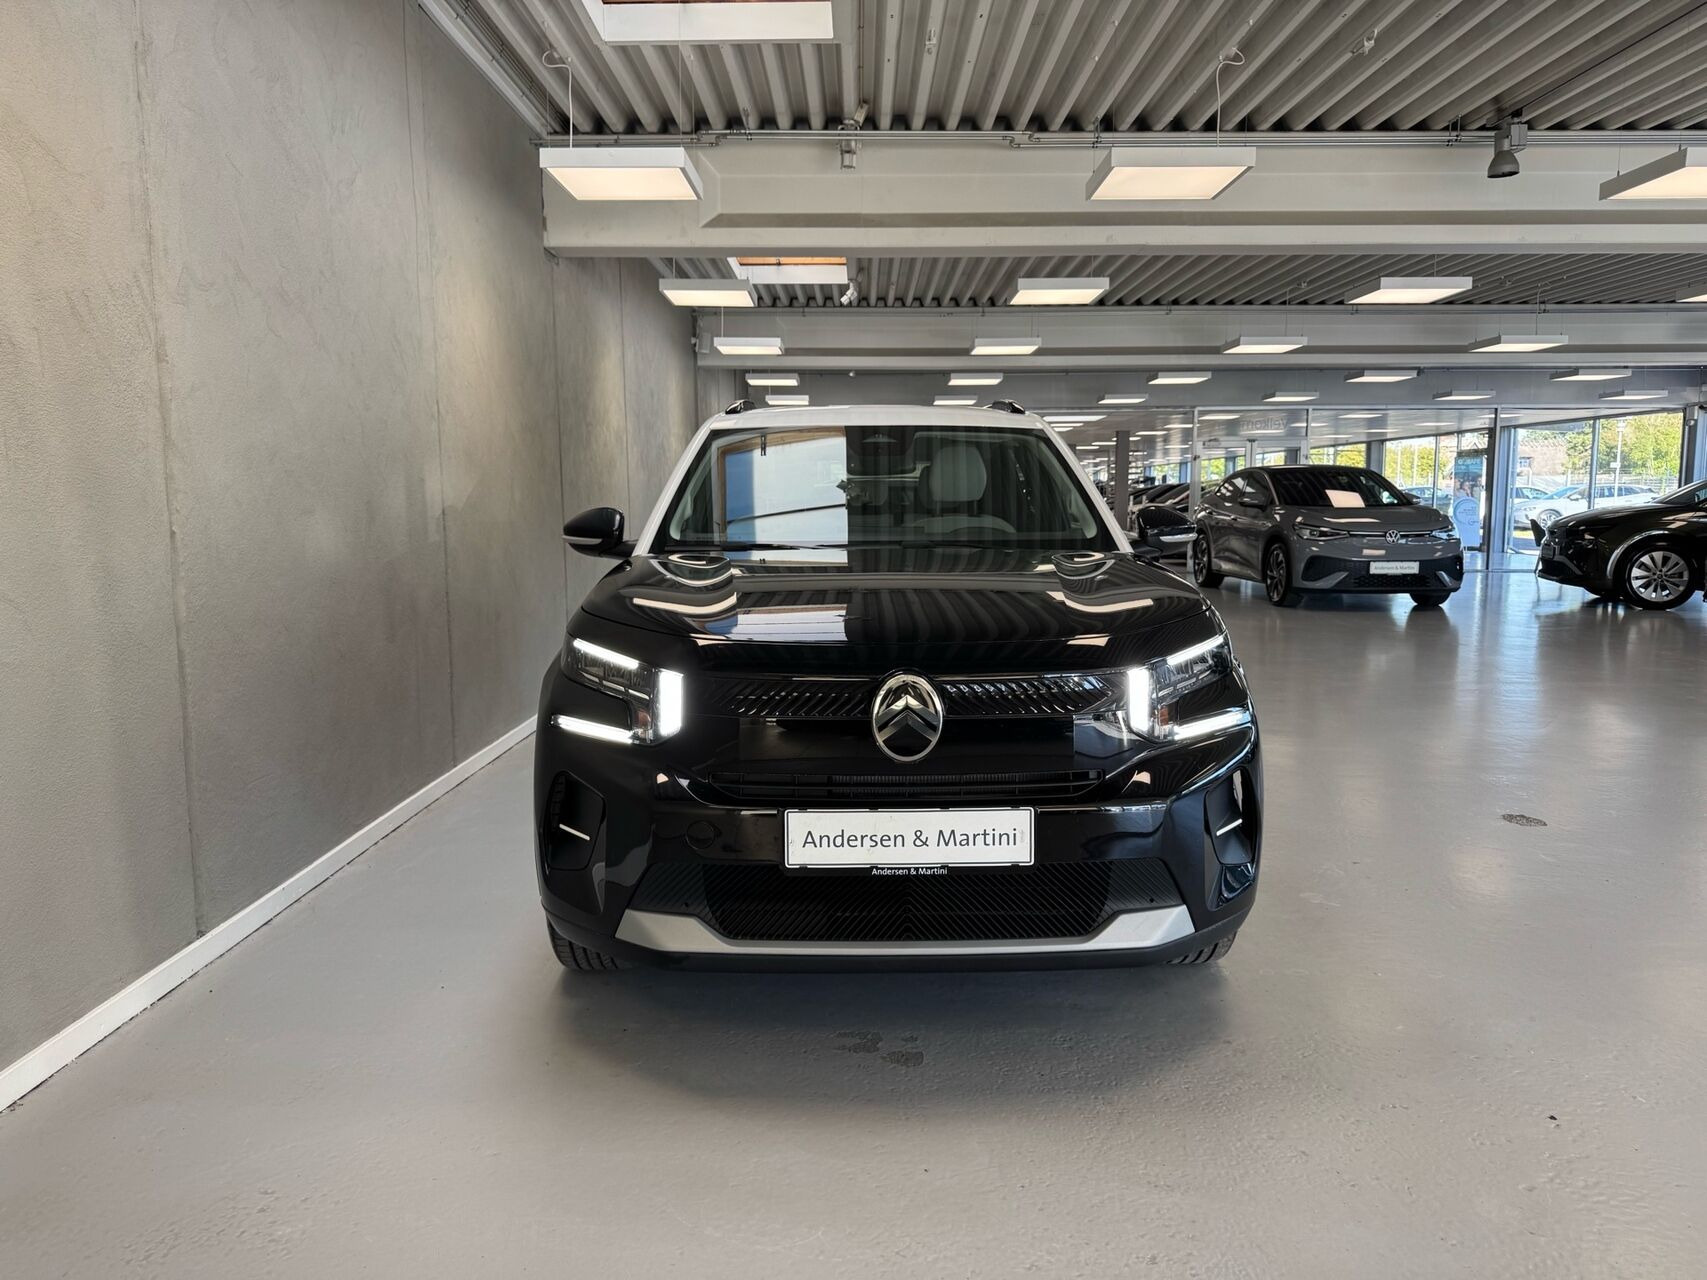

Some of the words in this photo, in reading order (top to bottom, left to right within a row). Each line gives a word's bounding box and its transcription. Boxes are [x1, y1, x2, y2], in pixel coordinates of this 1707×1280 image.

[802, 829, 905, 848] Andersen
[912, 829, 929, 847] &
[936, 828, 1018, 847] Martini
[871, 867, 909, 876] Andersen
[910, 867, 917, 876] &
[918, 867, 948, 876] Martini
